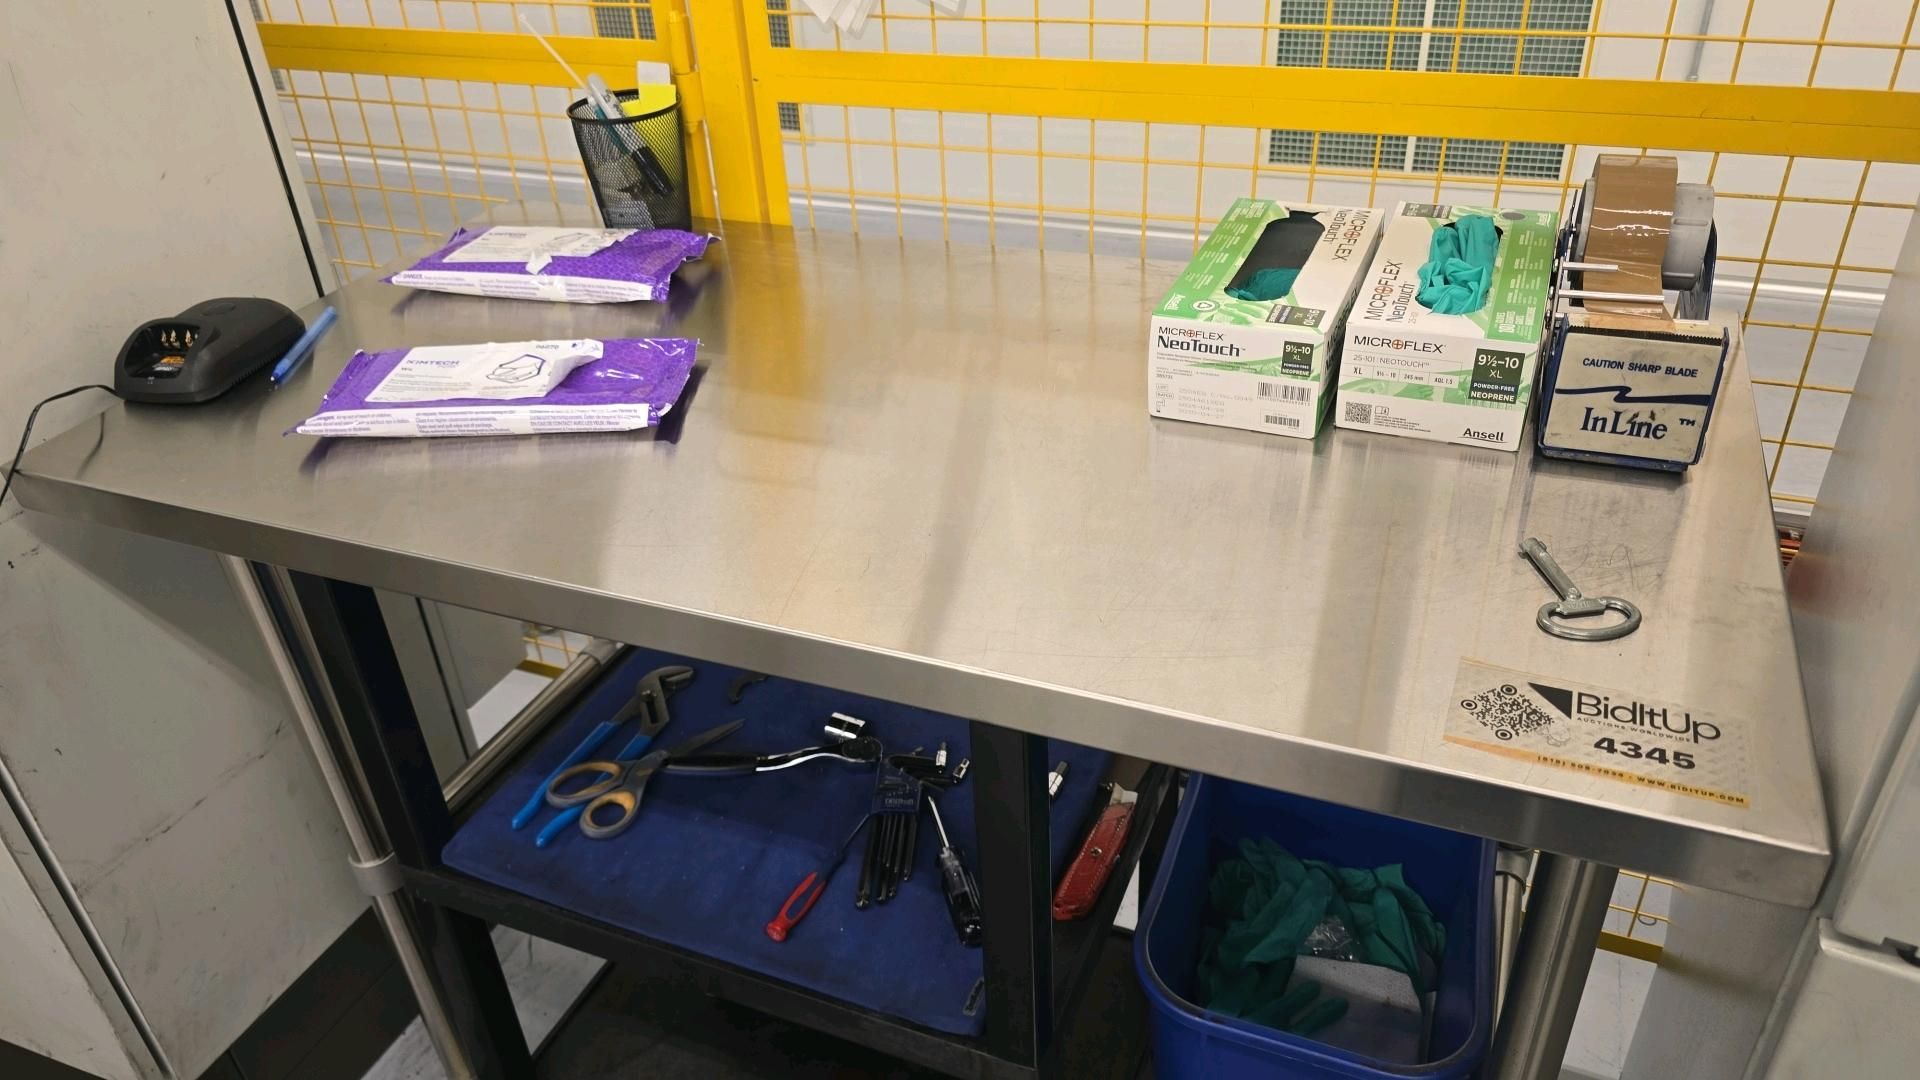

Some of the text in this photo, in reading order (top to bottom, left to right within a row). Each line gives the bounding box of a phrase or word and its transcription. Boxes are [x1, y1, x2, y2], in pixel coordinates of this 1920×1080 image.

[1363, 260, 1403, 321] MICROFLEX
[1158, 326, 1225, 342] MICROFLEX
[1353, 335, 1444, 354] MICROFLEX
[1353, 354, 1376, 364] 25-101
[1281, 368, 1310, 376] NEOPRENE
[1353, 366, 1363, 375] XL
[1488, 369, 1503, 379] XL
[1582, 358, 1698, 378] CAUTION SHARP BLADE
[1473, 382, 1516, 393] POWDER-FREE
[1471, 390, 1515, 403] NEOPRENE
[1462, 427, 1505, 442] Ansell
[1576, 691, 1721, 744] BidItUp
[1576, 717, 1691, 742] AUCTIONS WORLDWIDE
[1593, 737, 1696, 770] 4345
[1636, 776, 1745, 804] WWW.BIDITUP.COM
